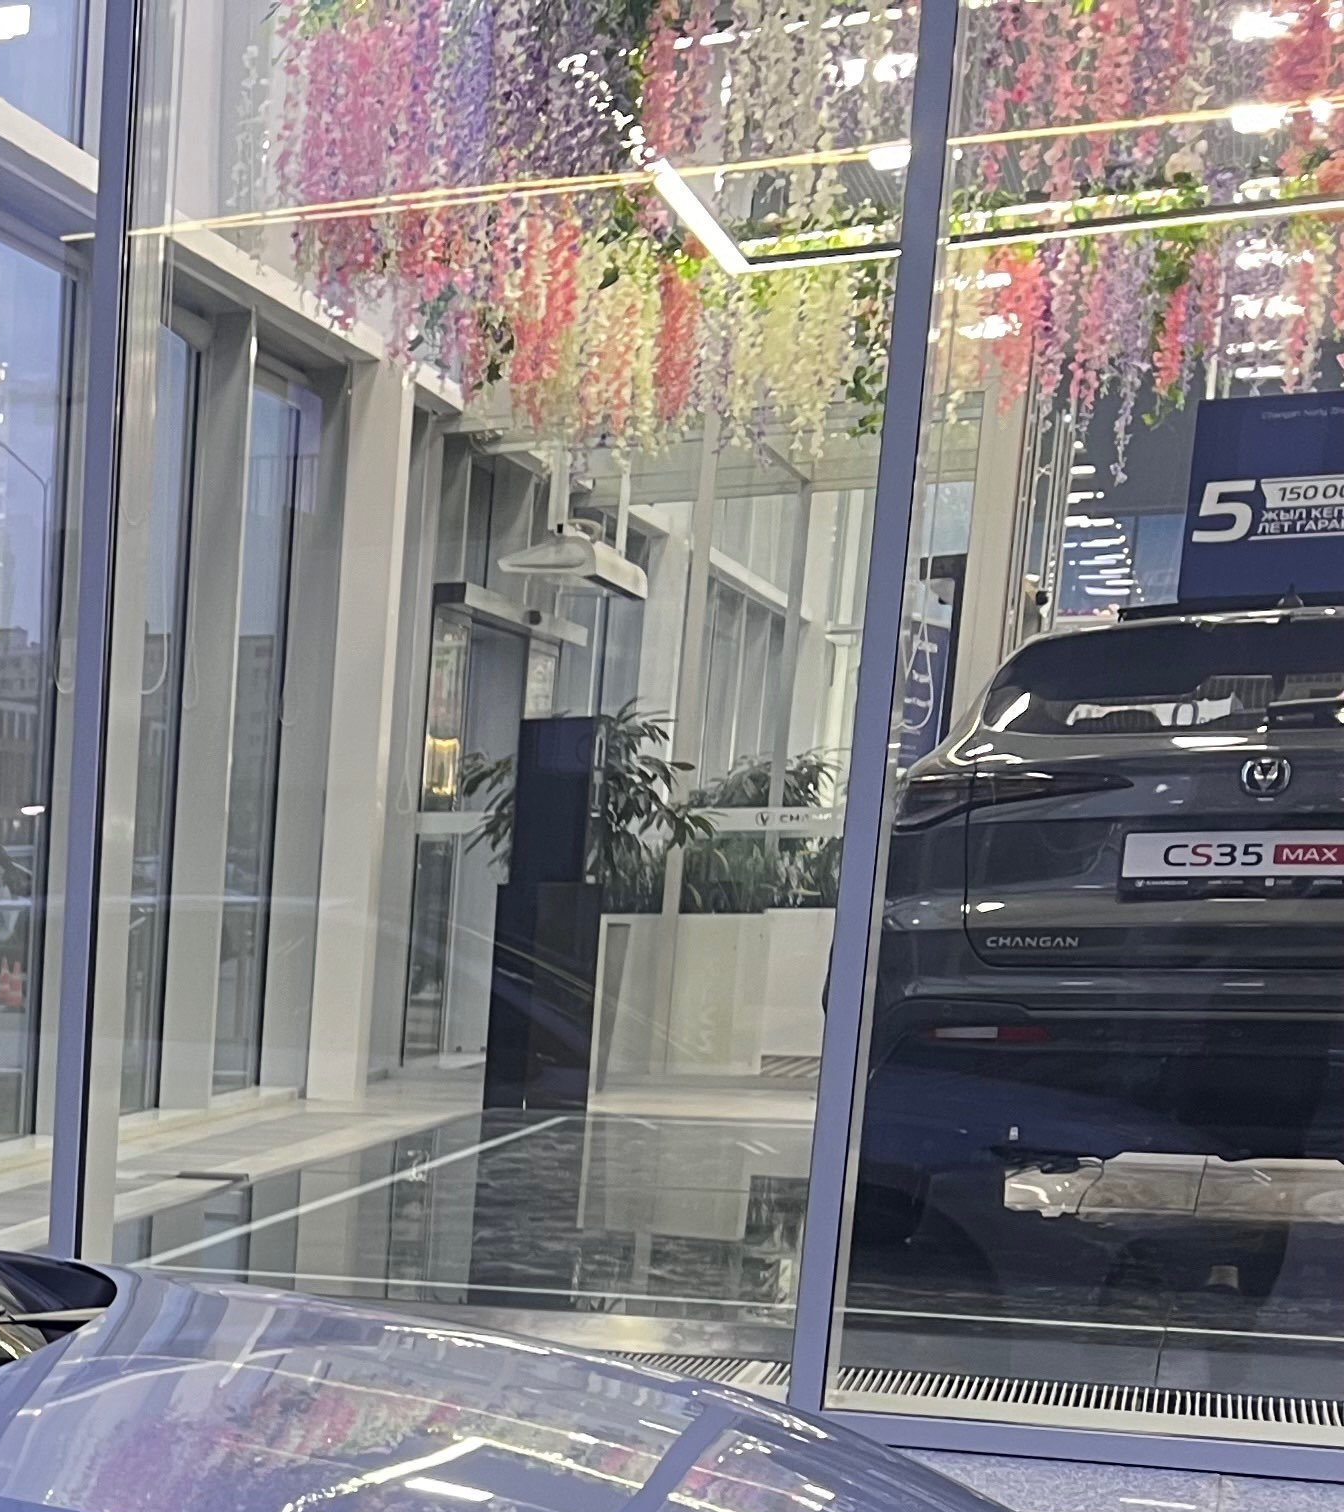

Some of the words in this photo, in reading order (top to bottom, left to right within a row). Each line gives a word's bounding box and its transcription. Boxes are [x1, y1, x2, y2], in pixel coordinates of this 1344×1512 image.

[1278, 484, 1318, 502] 150
[1191, 479, 1257, 543] 5
[1261, 508, 1307, 522] ЖЫЛ
[1257, 521, 1293, 535] ЛЕТ
[1163, 843, 1264, 867] CS35
[1282, 847, 1339, 862] MAX
[985, 936, 1080, 948] CHANGAN
